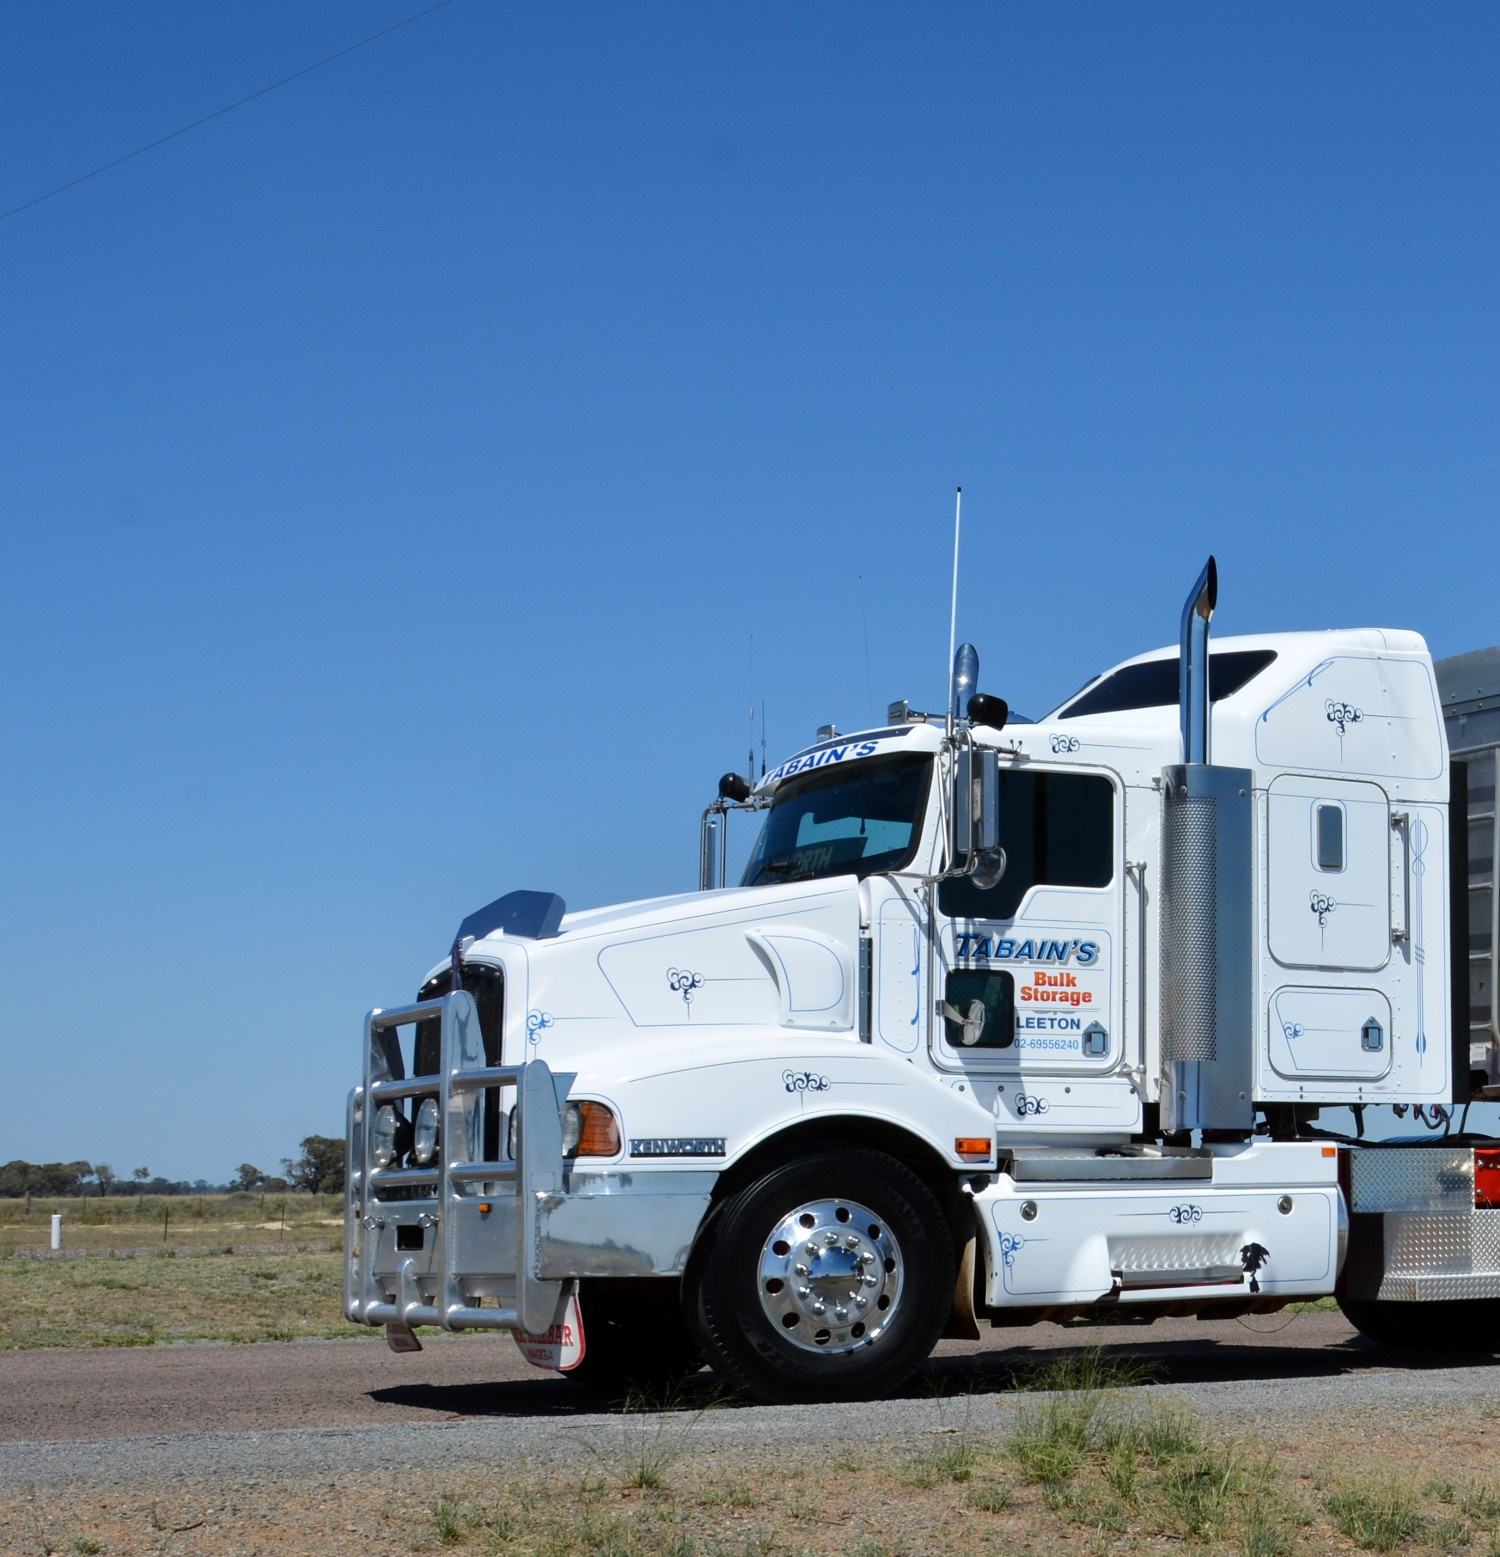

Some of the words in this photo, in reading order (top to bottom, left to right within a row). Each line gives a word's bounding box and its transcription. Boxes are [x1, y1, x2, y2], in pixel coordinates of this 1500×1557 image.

[764, 740, 880, 786] TABAIN'S
[955, 932, 1099, 965] TABAIN'S
[1034, 971, 1077, 987] Bulk
[1020, 986, 1093, 1006] Storage
[1016, 1017, 1081, 1030] LEETON
[629, 1139, 726, 1154] KENWORTH
